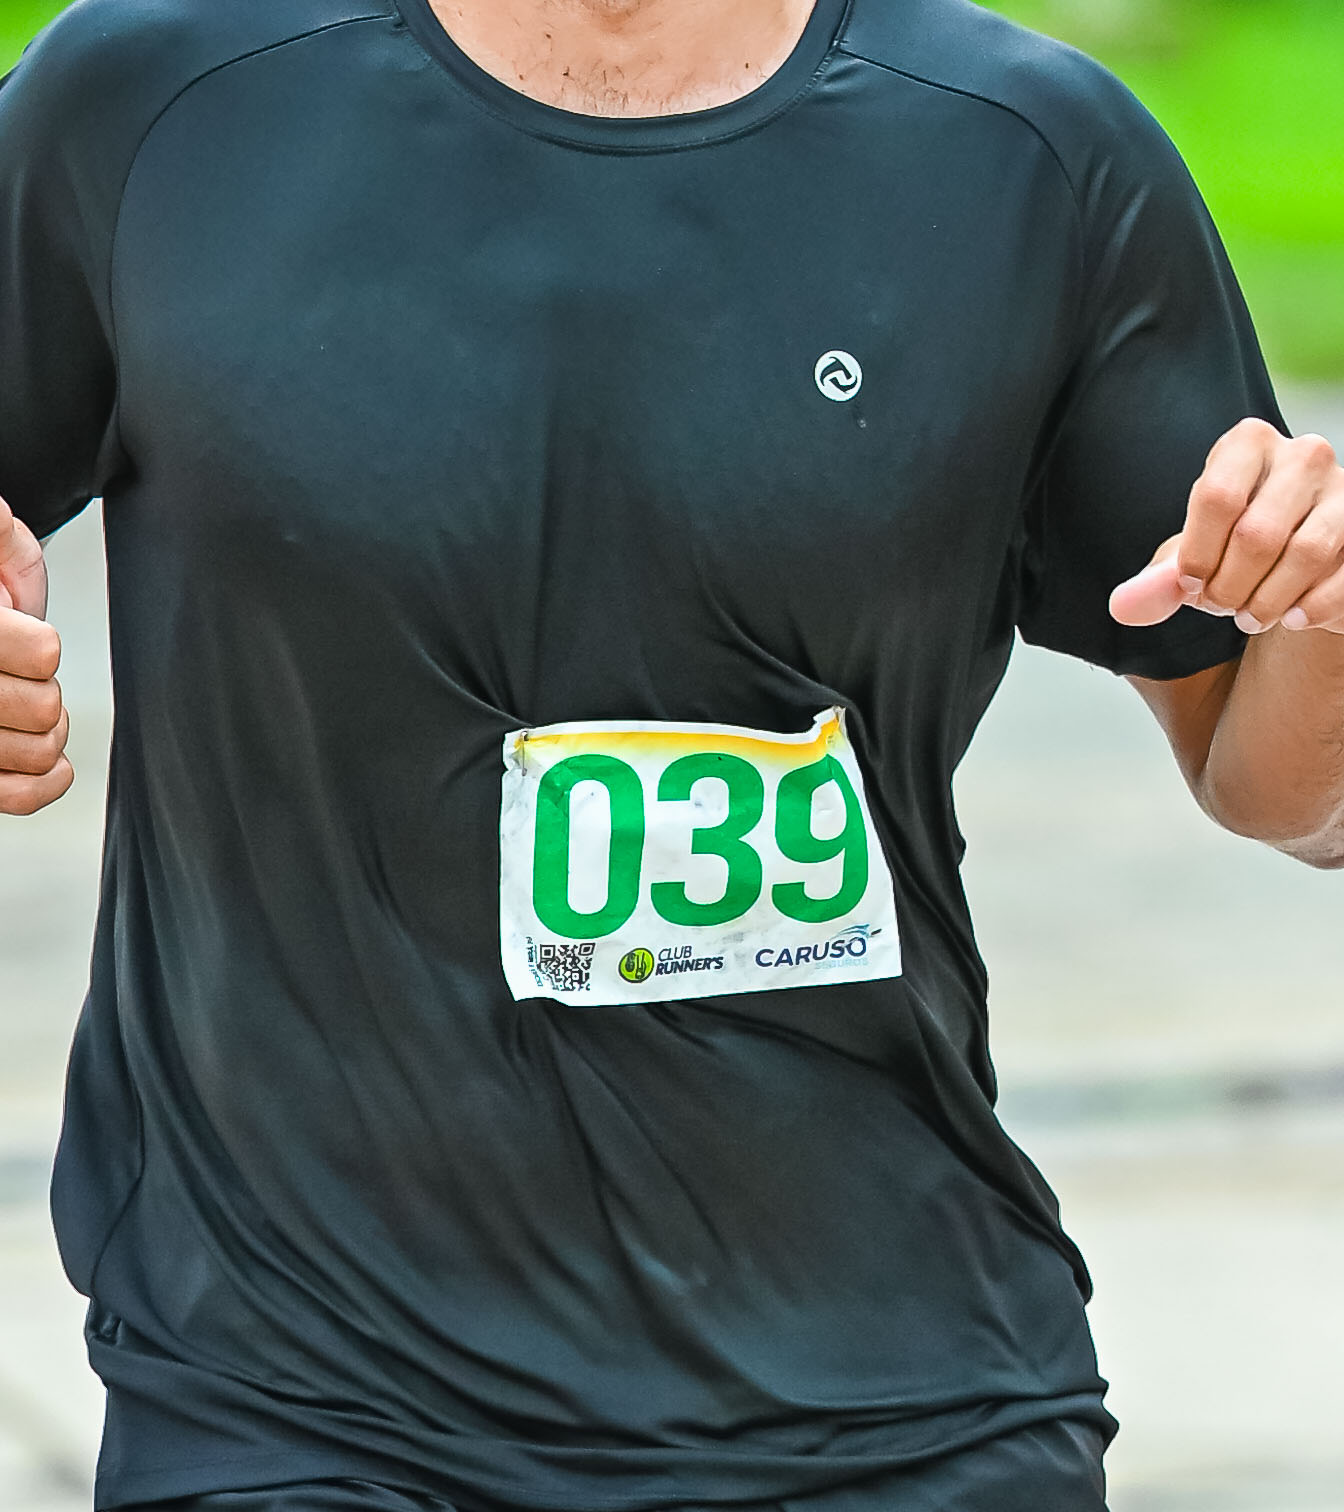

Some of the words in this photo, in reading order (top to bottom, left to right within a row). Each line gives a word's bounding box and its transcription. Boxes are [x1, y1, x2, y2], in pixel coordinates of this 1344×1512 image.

[533, 753, 868, 939] 039
[658, 945, 692, 962] CLUB
[755, 936, 867, 967] CARUSO
[656, 956, 724, 976] RUNNER'S
